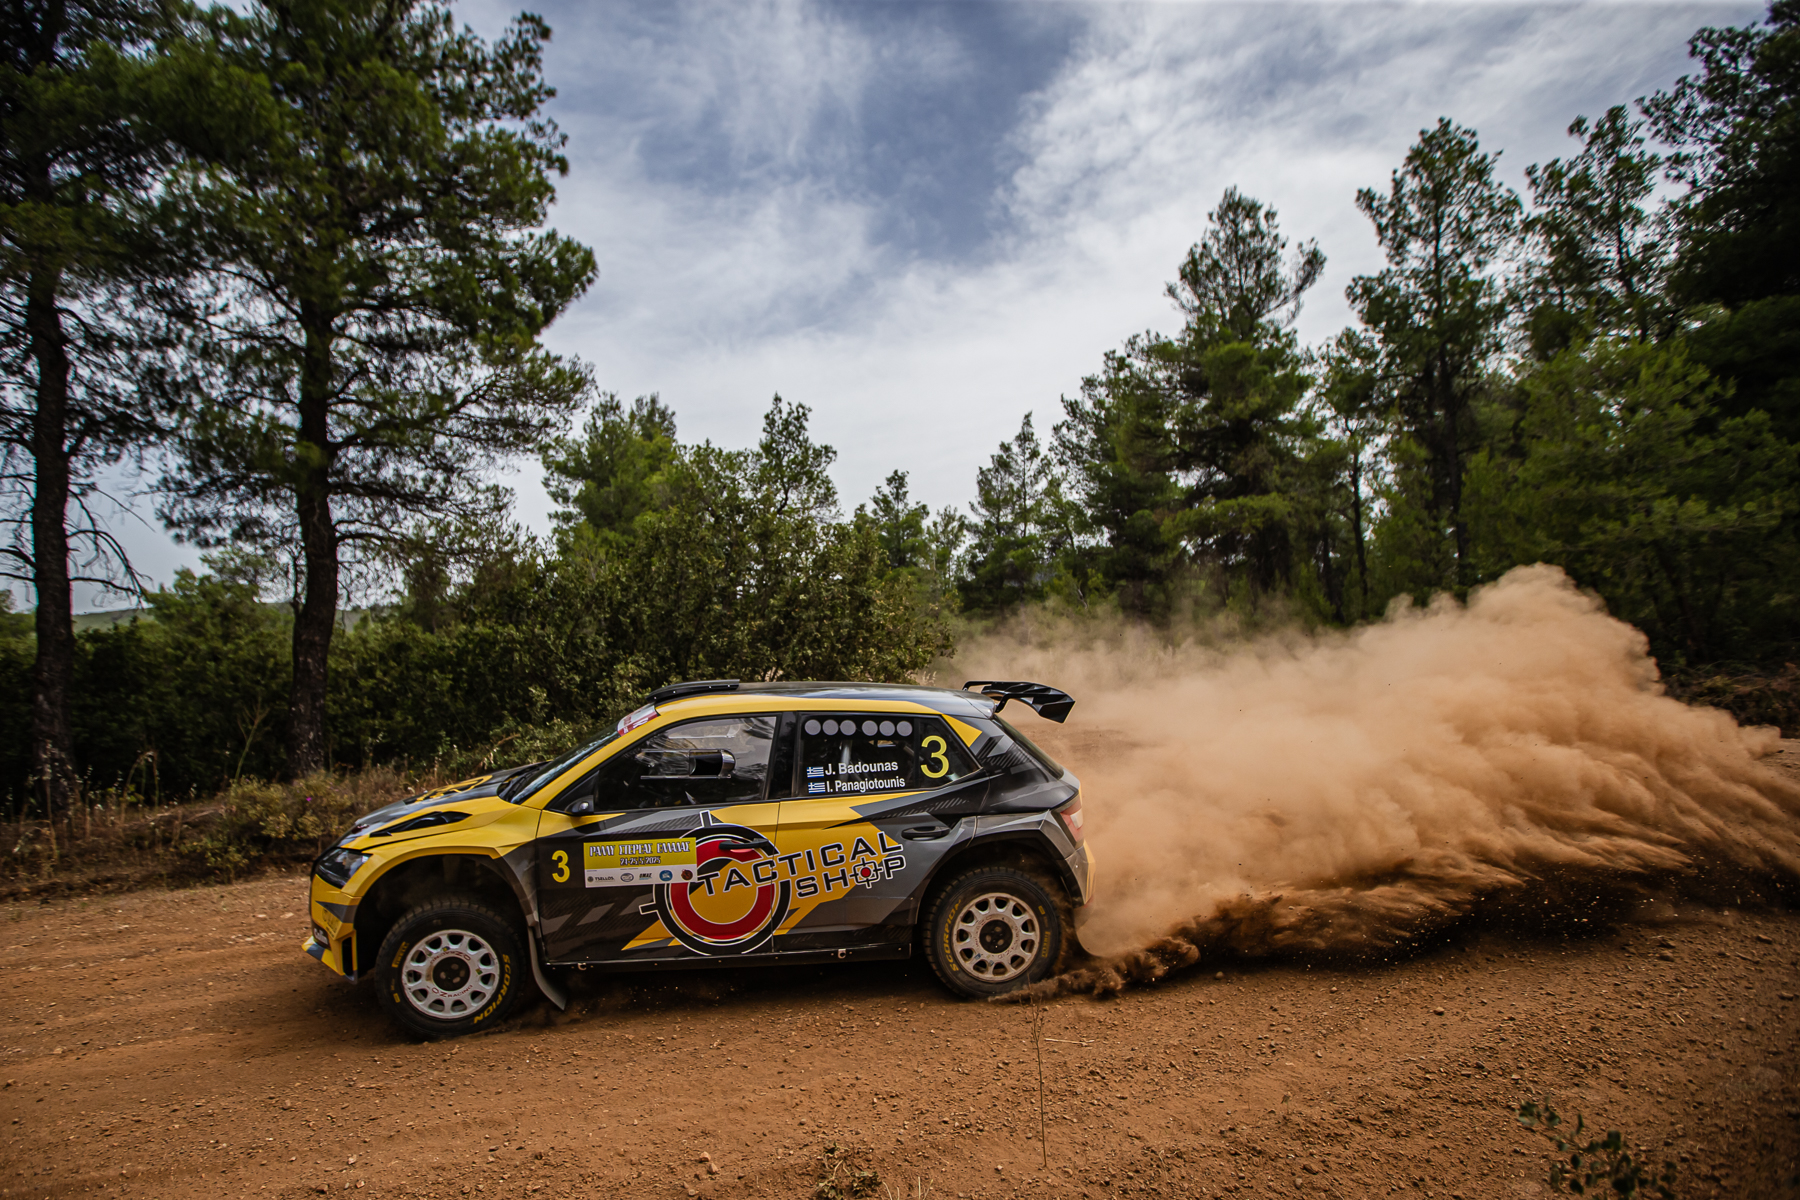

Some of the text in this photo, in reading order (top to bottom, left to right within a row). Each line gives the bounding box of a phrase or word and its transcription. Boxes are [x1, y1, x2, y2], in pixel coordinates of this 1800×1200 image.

[825, 761, 899, 776] J. Badounas
[921, 735, 950, 779] 3
[826, 776, 906, 793] I. Panagiotounis
[551, 850, 571, 883] 3
[697, 831, 904, 896] TACTICAL
[796, 855, 906, 899] SHOP
[473, 954, 511, 1024] SCORPION
